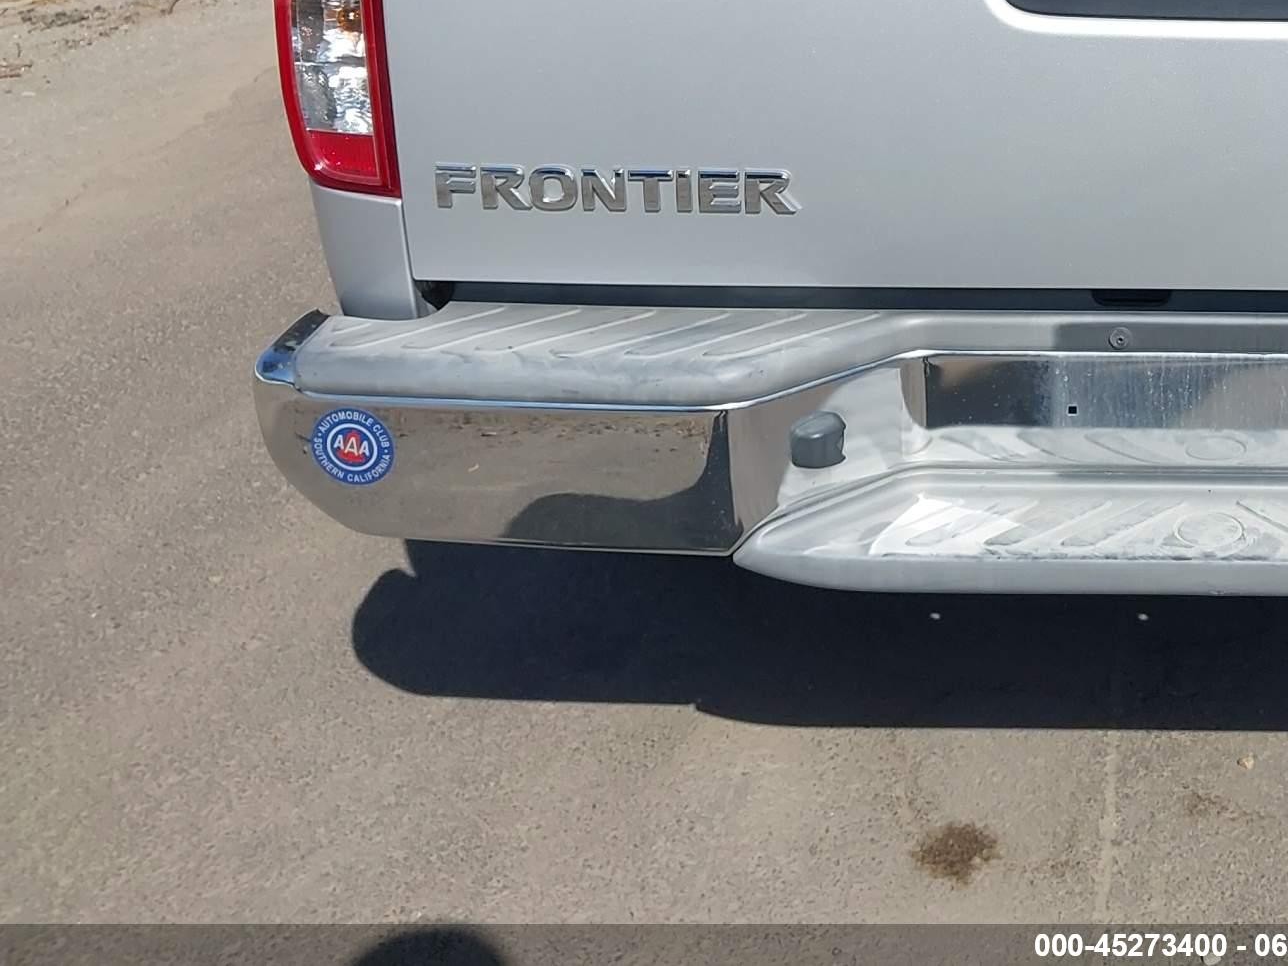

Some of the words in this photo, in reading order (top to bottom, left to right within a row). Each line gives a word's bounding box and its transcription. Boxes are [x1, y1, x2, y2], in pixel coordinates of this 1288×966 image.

[435, 162, 801, 214] FRONTIER
[318, 410, 374, 433] AUTOMOBILE
[372, 422, 390, 448] CLUB
[333, 434, 370, 456] AAA
[313, 438, 345, 479] SOUTHERN
[347, 454, 391, 483] CALIFORNIA
